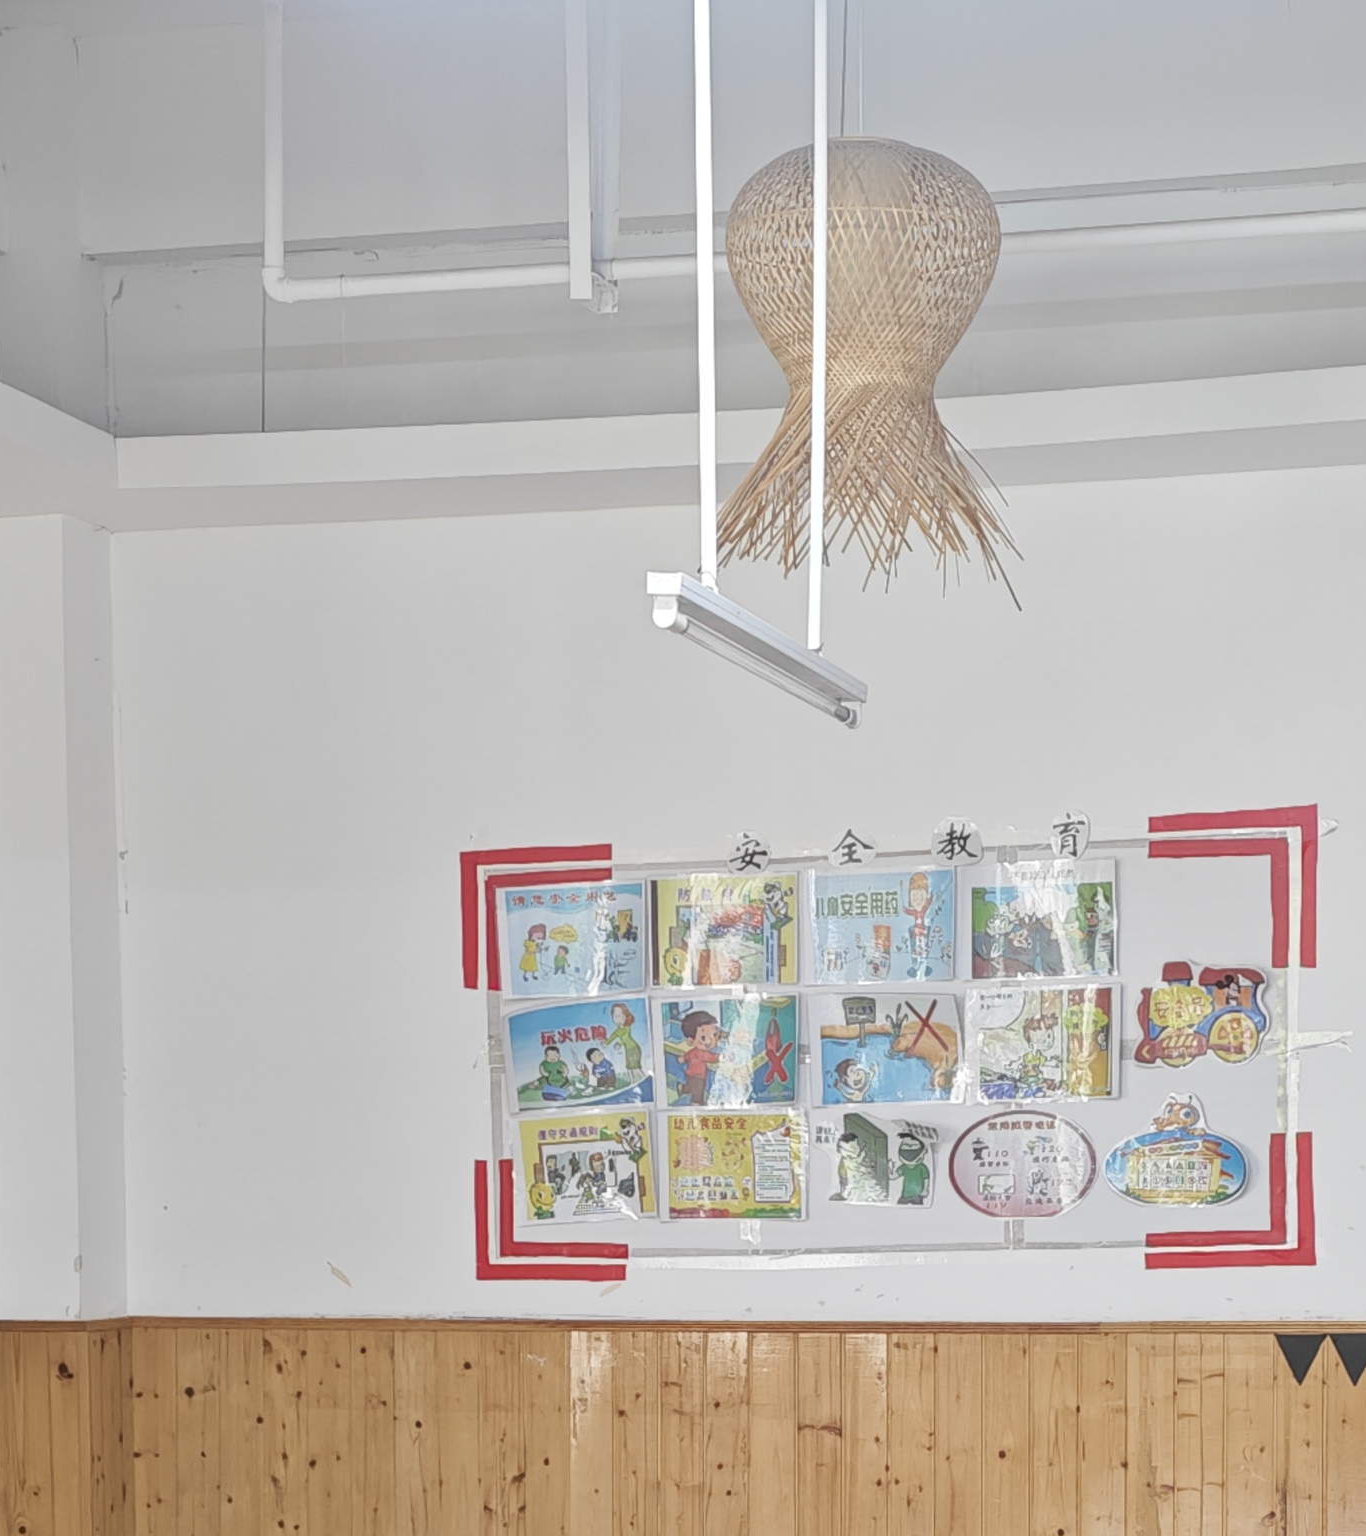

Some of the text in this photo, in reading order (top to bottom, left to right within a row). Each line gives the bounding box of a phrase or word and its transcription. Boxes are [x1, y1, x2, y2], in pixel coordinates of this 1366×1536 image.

[729, 812, 1087, 871] 安全教育
[540, 1024, 607, 1046] 玩火危险
[673, 1116, 748, 1131] 幼儿食品安全
[986, 1150, 1009, 1159] 110
